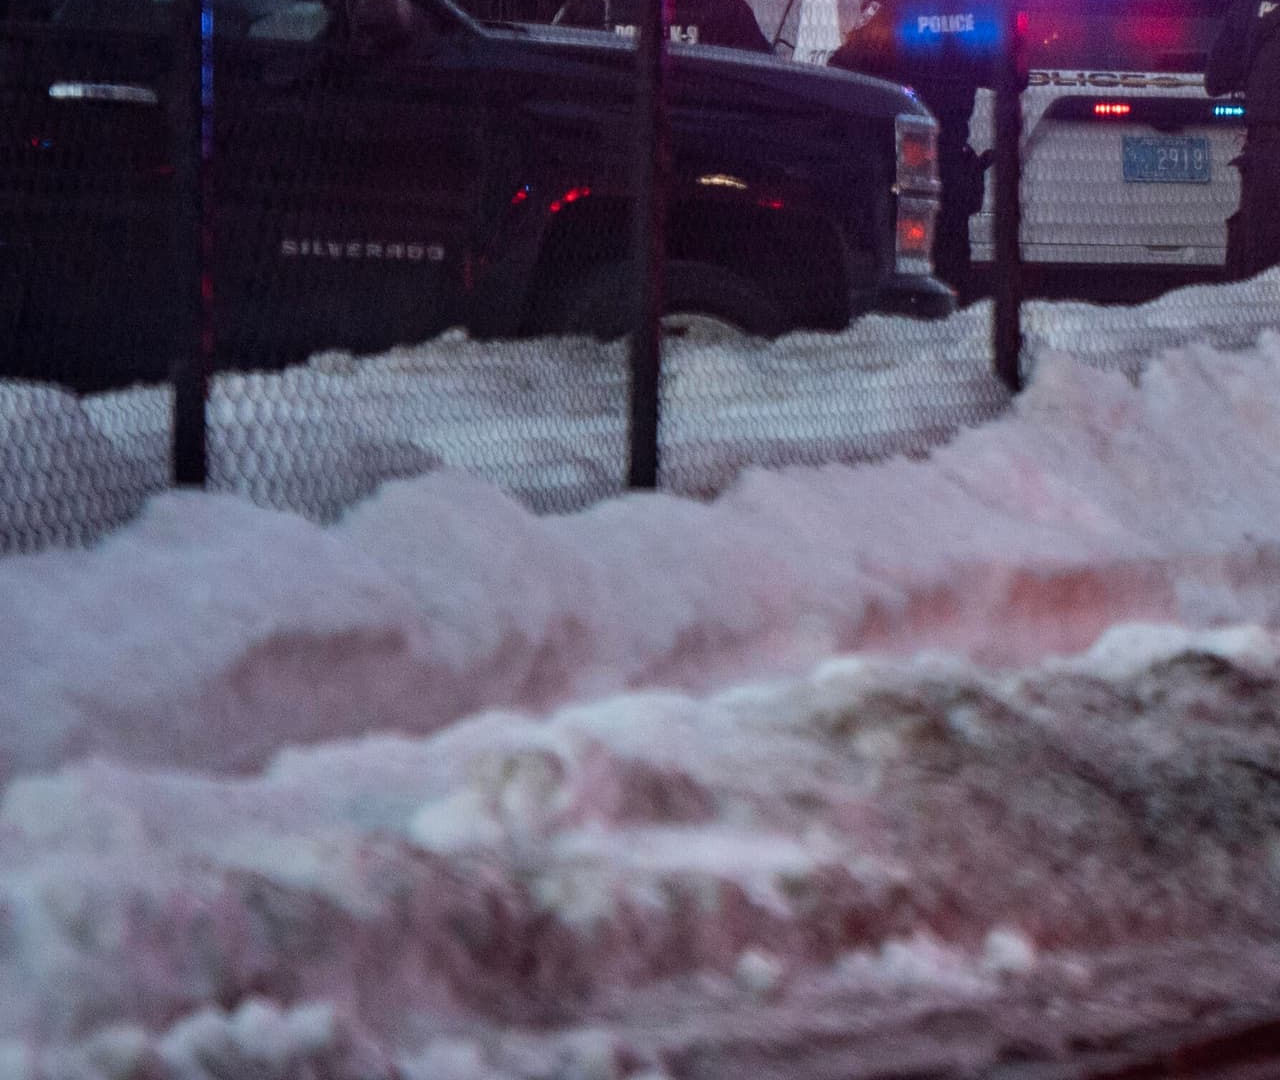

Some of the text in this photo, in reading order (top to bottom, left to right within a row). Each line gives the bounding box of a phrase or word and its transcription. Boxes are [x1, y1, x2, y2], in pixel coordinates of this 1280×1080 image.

[917, 13, 975, 34] POLICE
[1028, 72, 1147, 89] OLICE
[282, 240, 445, 261] SILVERADO
